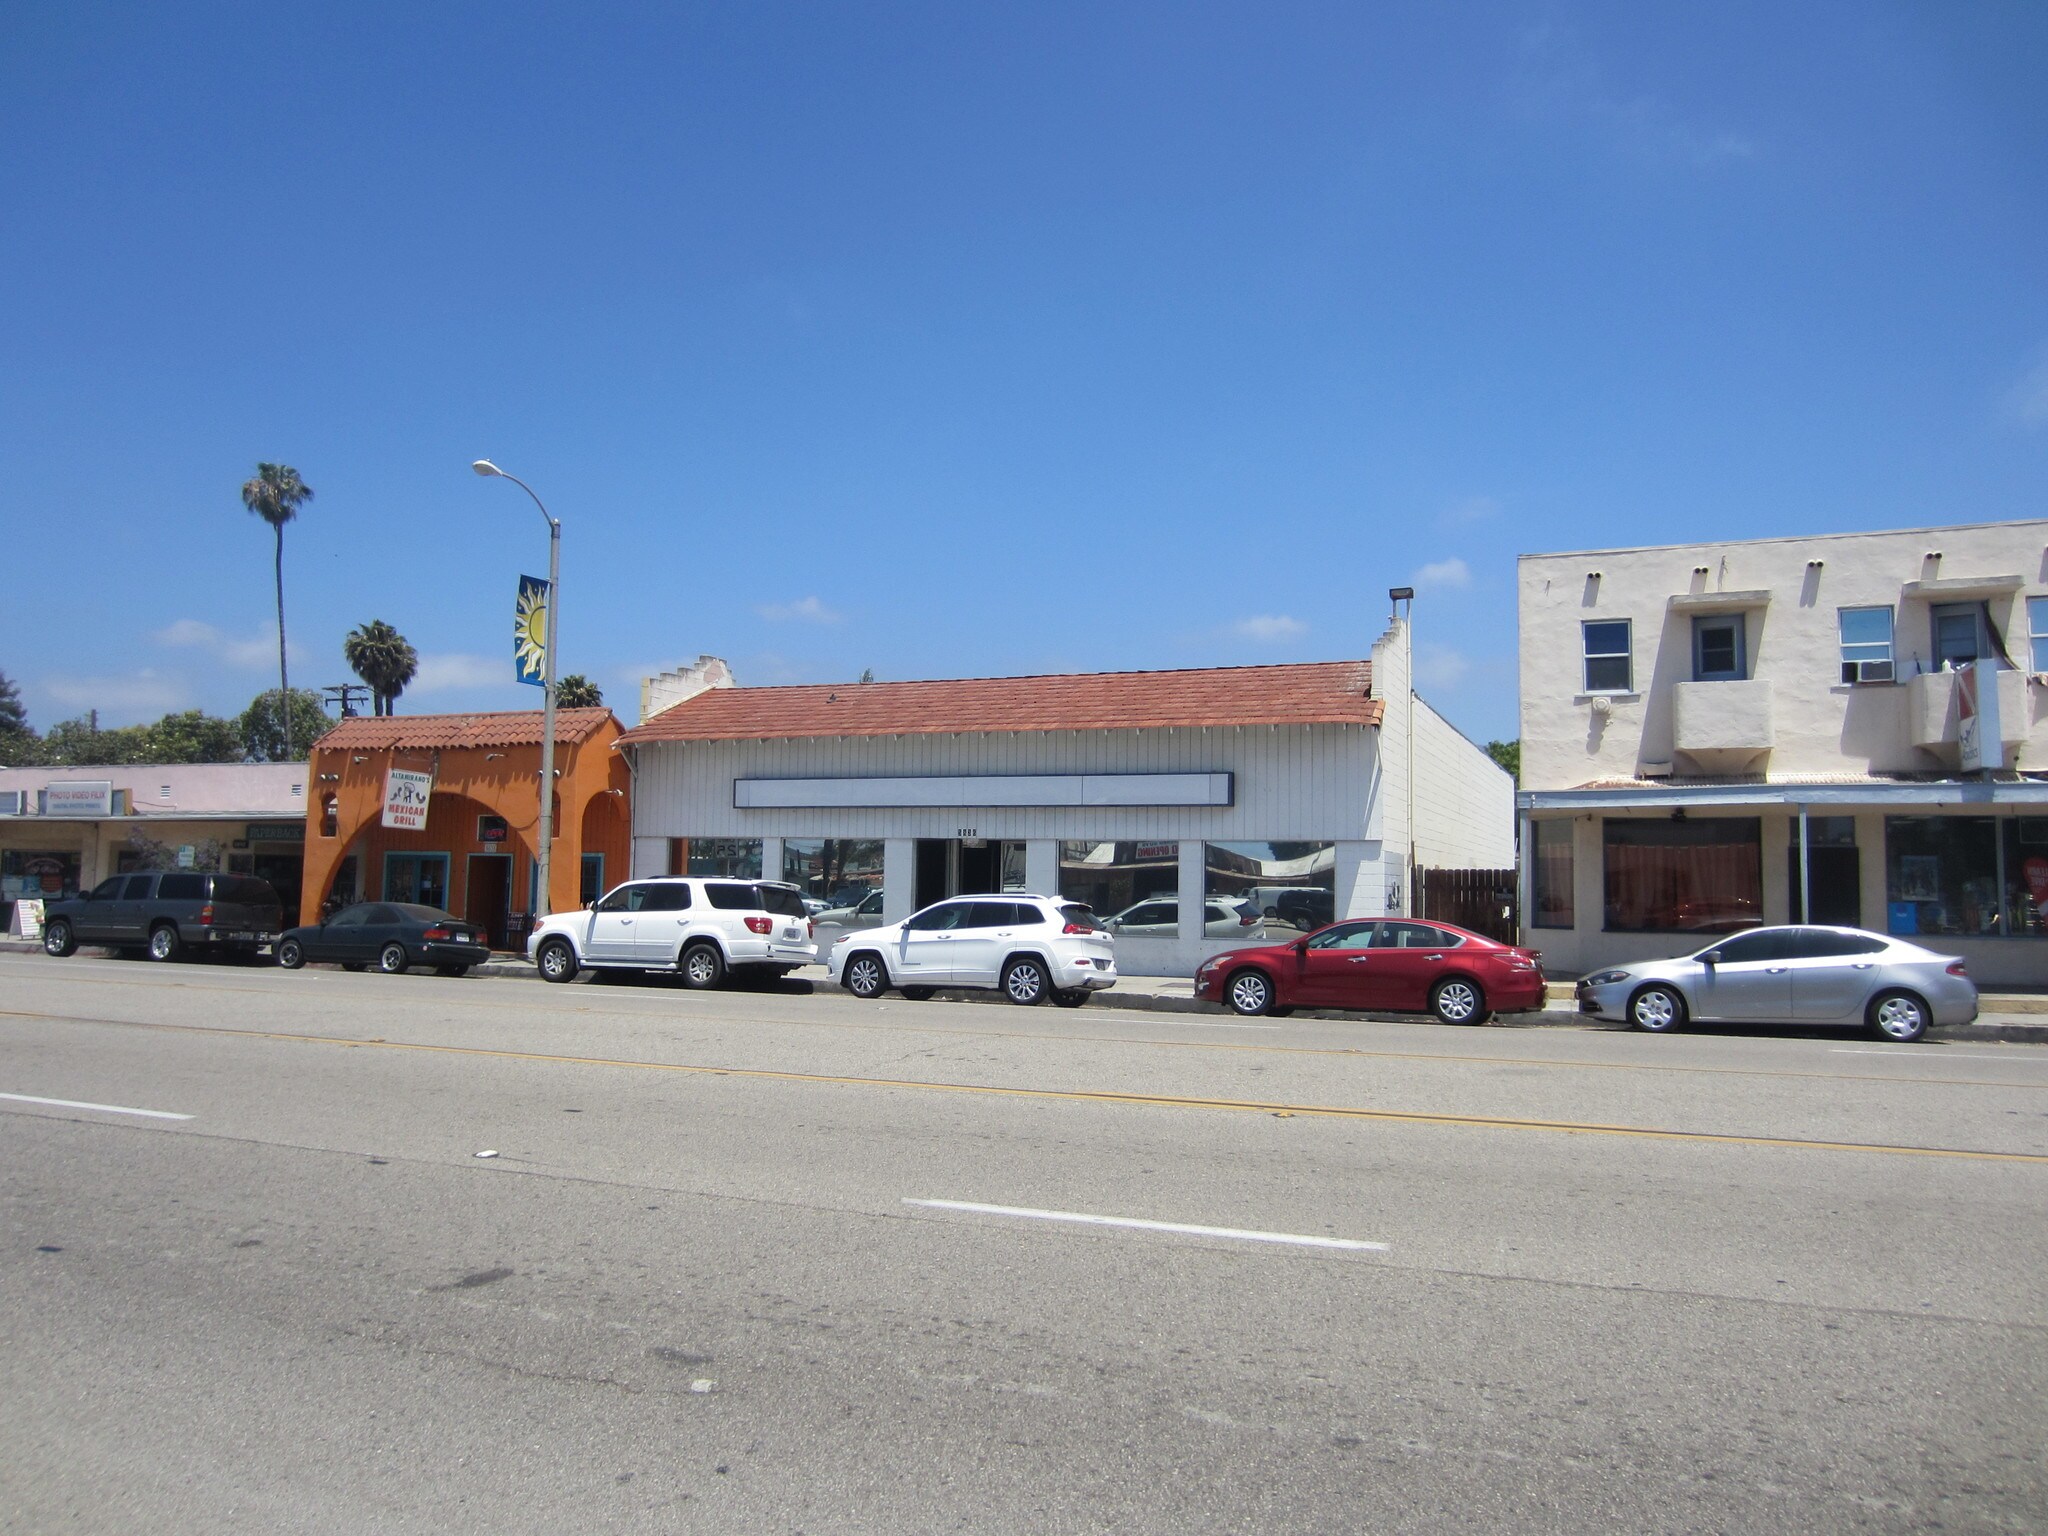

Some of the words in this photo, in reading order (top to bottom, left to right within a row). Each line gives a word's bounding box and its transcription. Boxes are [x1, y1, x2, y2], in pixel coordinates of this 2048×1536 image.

[49, 791, 71, 800] PHOTO
[72, 791, 90, 800] VIDEO
[388, 804, 425, 816] MEXICAN
[393, 815, 416, 826] GRILL
[250, 827, 301, 838] PAPERBACK
